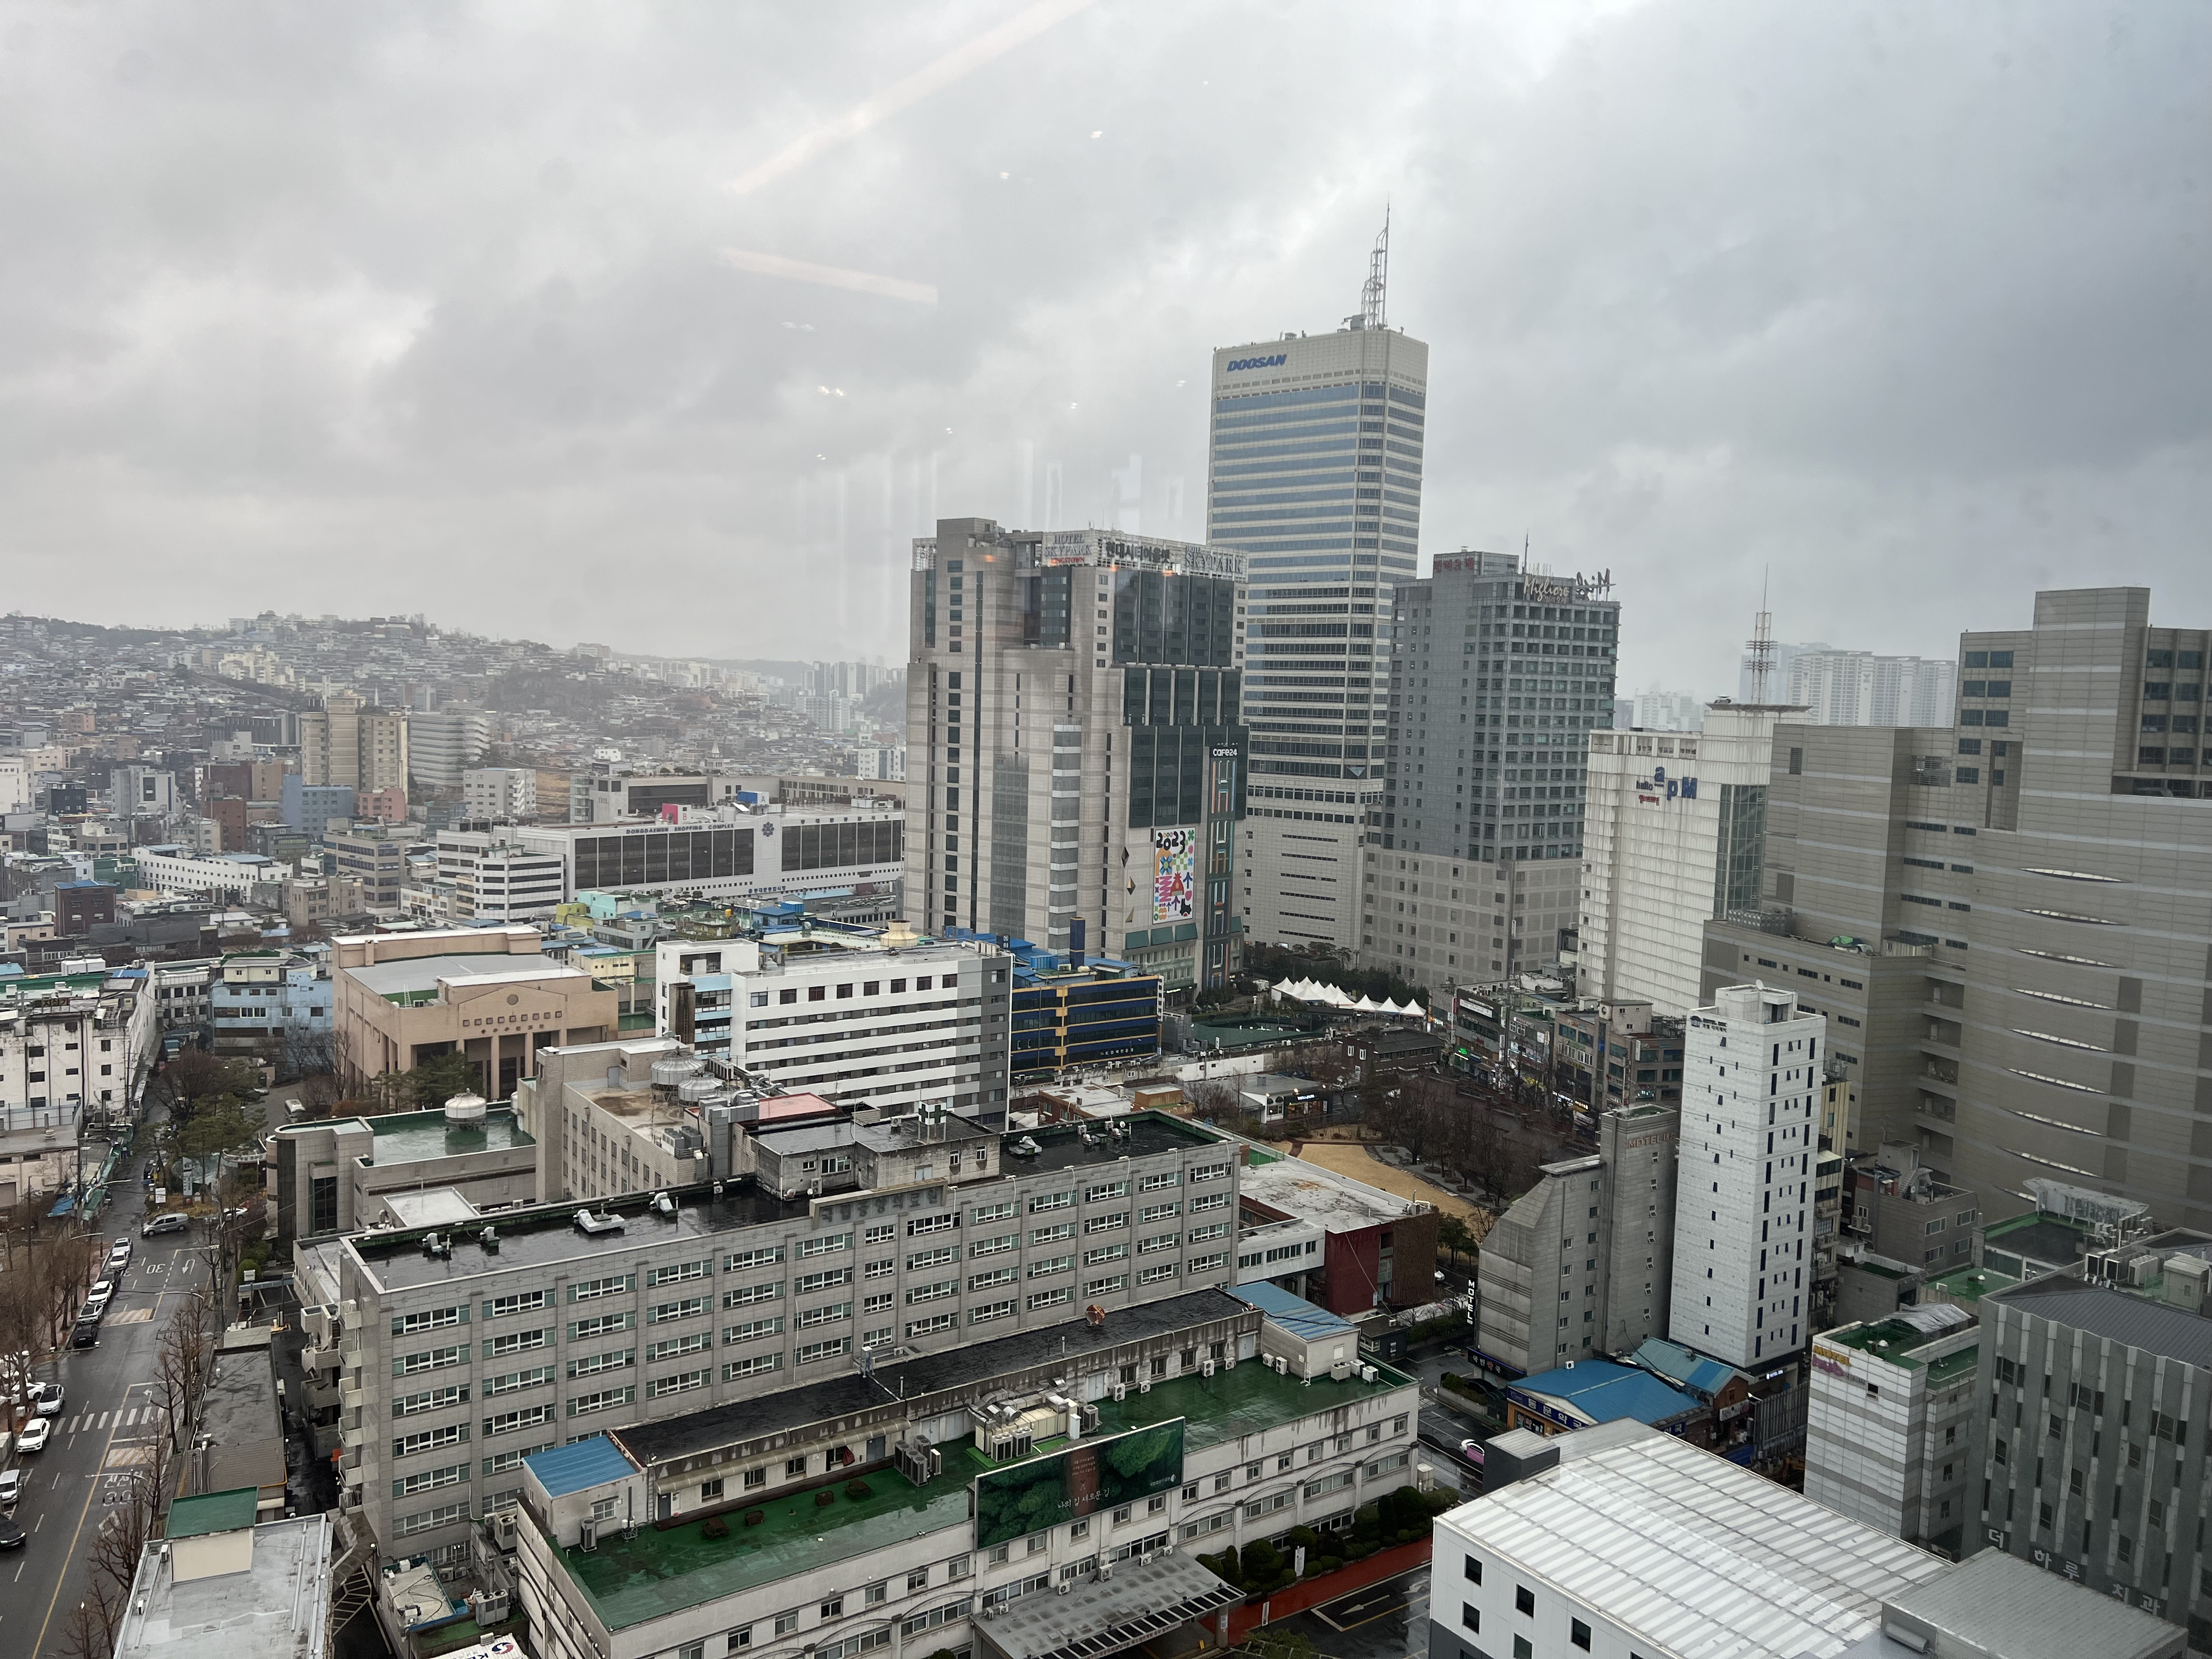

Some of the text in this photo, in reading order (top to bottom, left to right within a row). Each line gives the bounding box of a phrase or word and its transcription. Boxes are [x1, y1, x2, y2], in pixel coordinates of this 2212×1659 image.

[1227, 354, 1287, 373] DOOSAN
[1054, 533, 1085, 545] HOTEL
[1044, 544, 1092, 557] SKYPARK
[1105, 540, 1170, 564] 현대시티아울렛
[1185, 551, 1243, 574] SKYPARK
[1523, 574, 1569, 602] Migliore
[1543, 595, 1567, 604] 밀리오레
[760, 795, 766, 804] A
[682, 812, 687, 821] B
[1156, 830, 1186, 855] 2023
[821, 1188, 940, 1223] 국립중앙의료원
[1467, 1279, 1475, 1320] MOTEL
[1472, 1355, 1502, 1374] 국민약국
[1058, 1499, 1071, 1509] 나의
[1081, 1489, 1102, 1503] 새로운
[1988, 1528, 2160, 1616] 더 하루 치과
